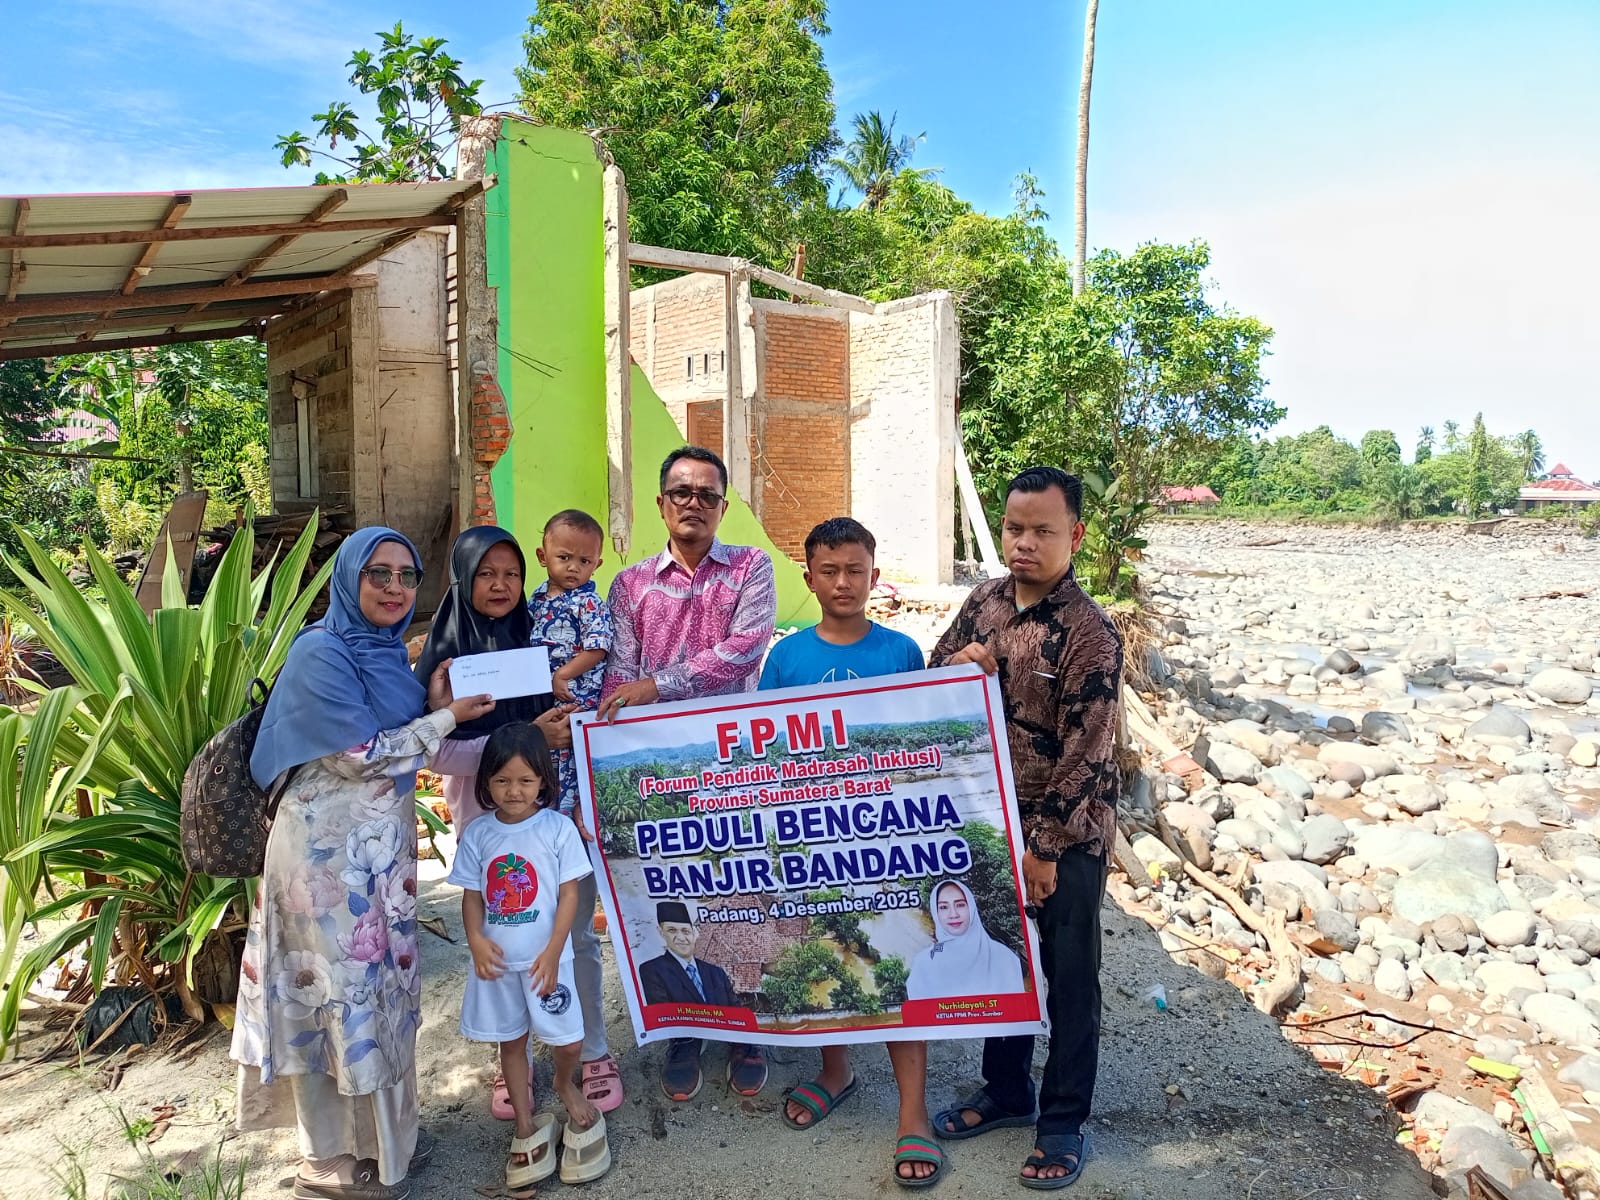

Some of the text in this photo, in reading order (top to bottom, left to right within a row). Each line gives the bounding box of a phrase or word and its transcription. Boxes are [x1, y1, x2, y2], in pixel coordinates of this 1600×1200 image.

[640, 746, 942, 799] (Forum Pendidik Madrasah Inklusi)
[688, 777, 892, 812] Provinsi Sumatera Barat
[637, 794, 961, 854] PEDULI BENCANA
[643, 839, 969, 894] BANJIR BANDANG
[698, 890, 920, 924] Padang, 4 Desember 2025
[938, 999, 997, 1011] Nurhidayati, ST
